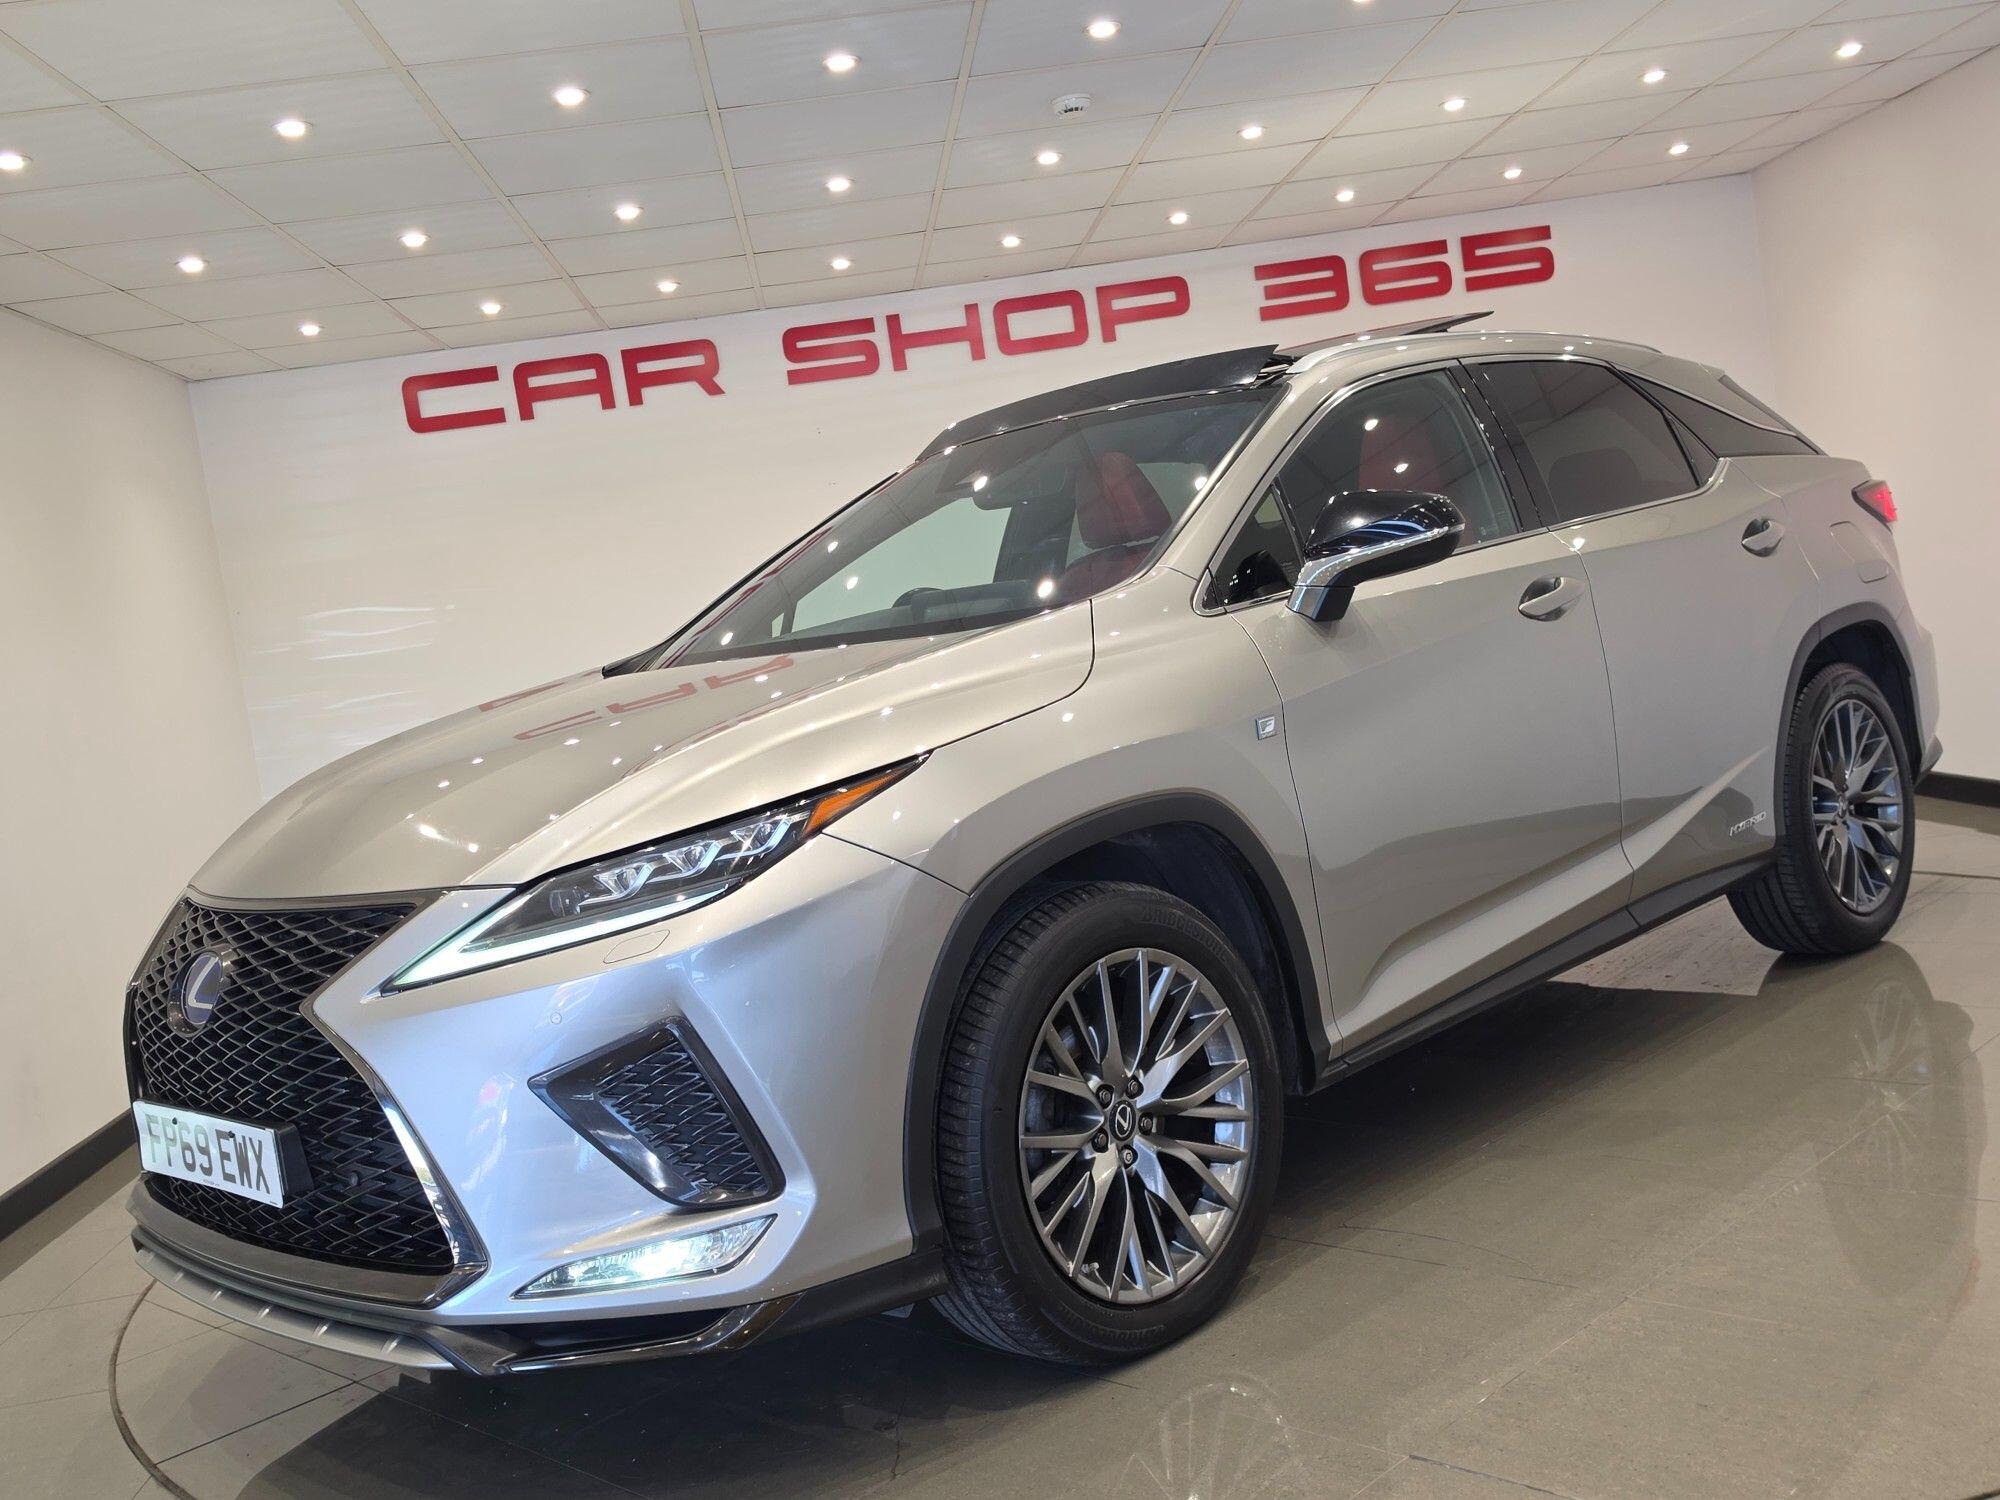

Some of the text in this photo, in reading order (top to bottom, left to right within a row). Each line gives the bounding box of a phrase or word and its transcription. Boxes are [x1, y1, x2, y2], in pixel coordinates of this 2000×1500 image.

[402, 225, 1555, 434] CAR SHOP 365
[1141, 905, 1231, 961] BRIDGESTONE
[145, 1113, 271, 1194] FP69 EWX
